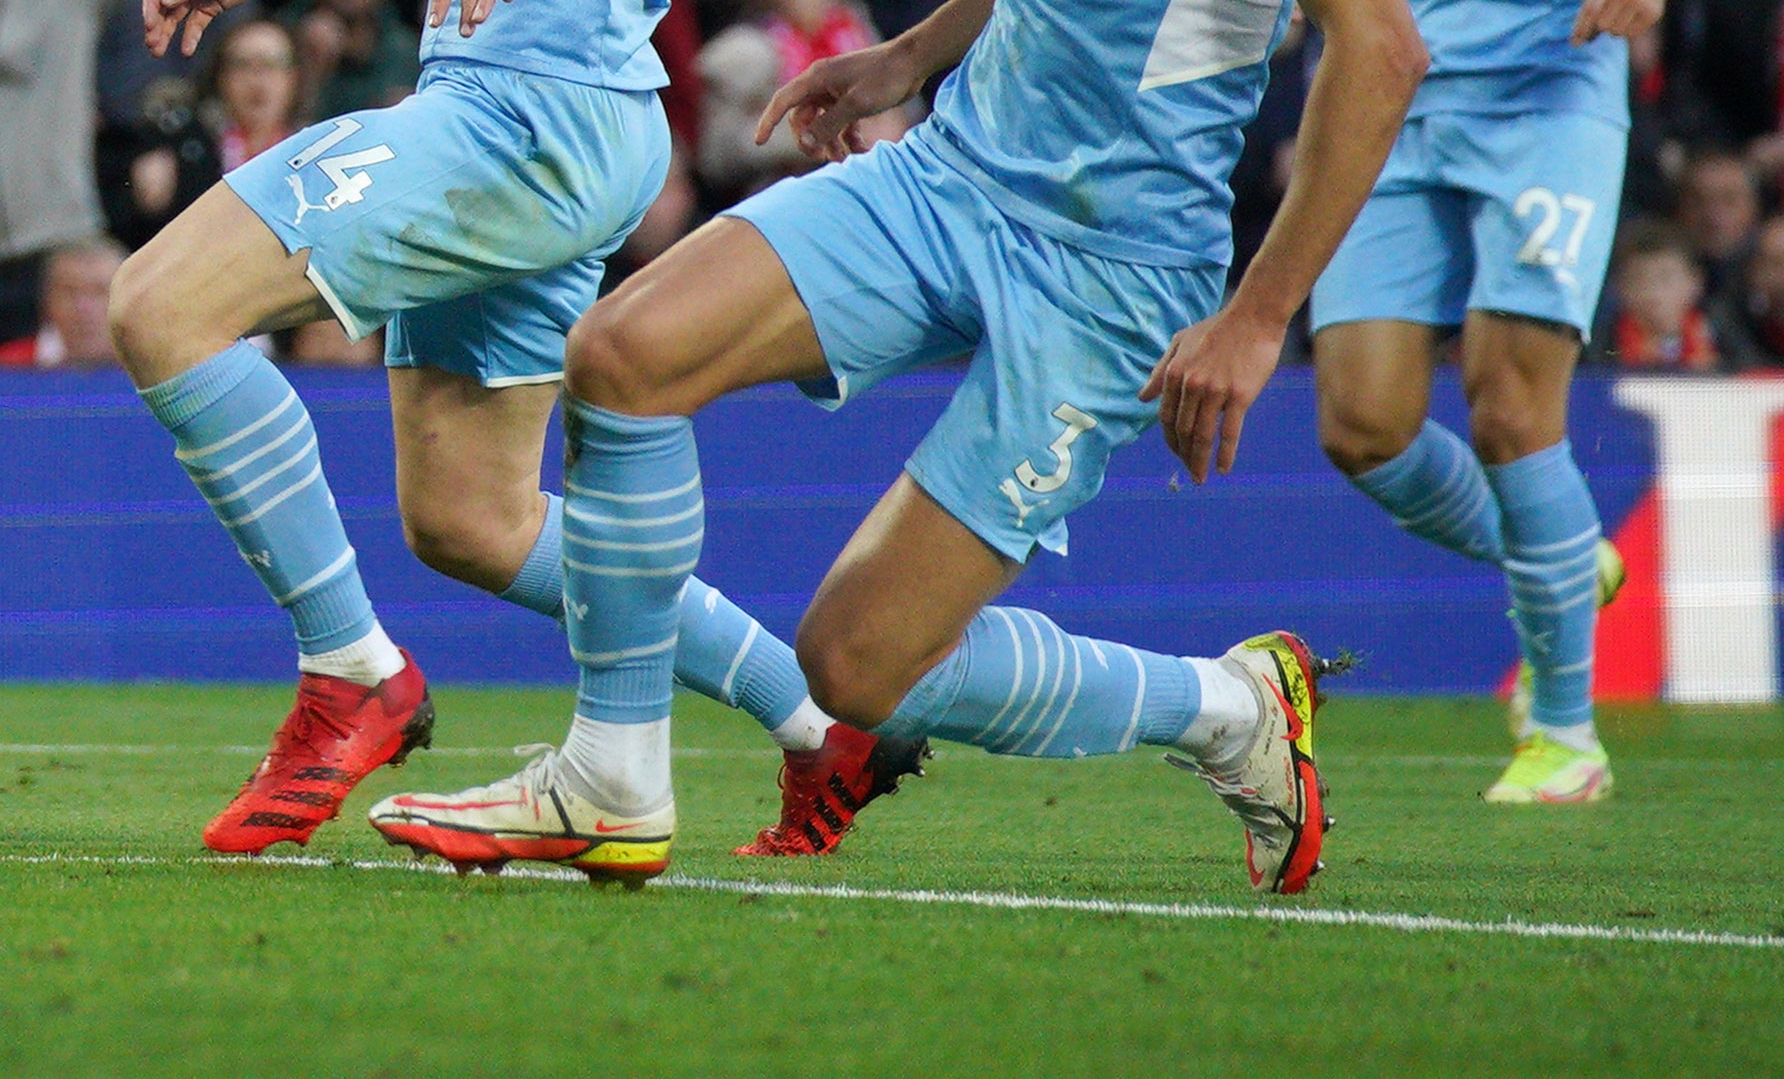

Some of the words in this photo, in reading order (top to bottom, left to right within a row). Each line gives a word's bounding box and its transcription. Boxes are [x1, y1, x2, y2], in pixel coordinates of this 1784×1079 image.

[286, 117, 398, 211] 14
[1514, 186, 1597, 267] 27
[1014, 401, 1099, 494] 3
